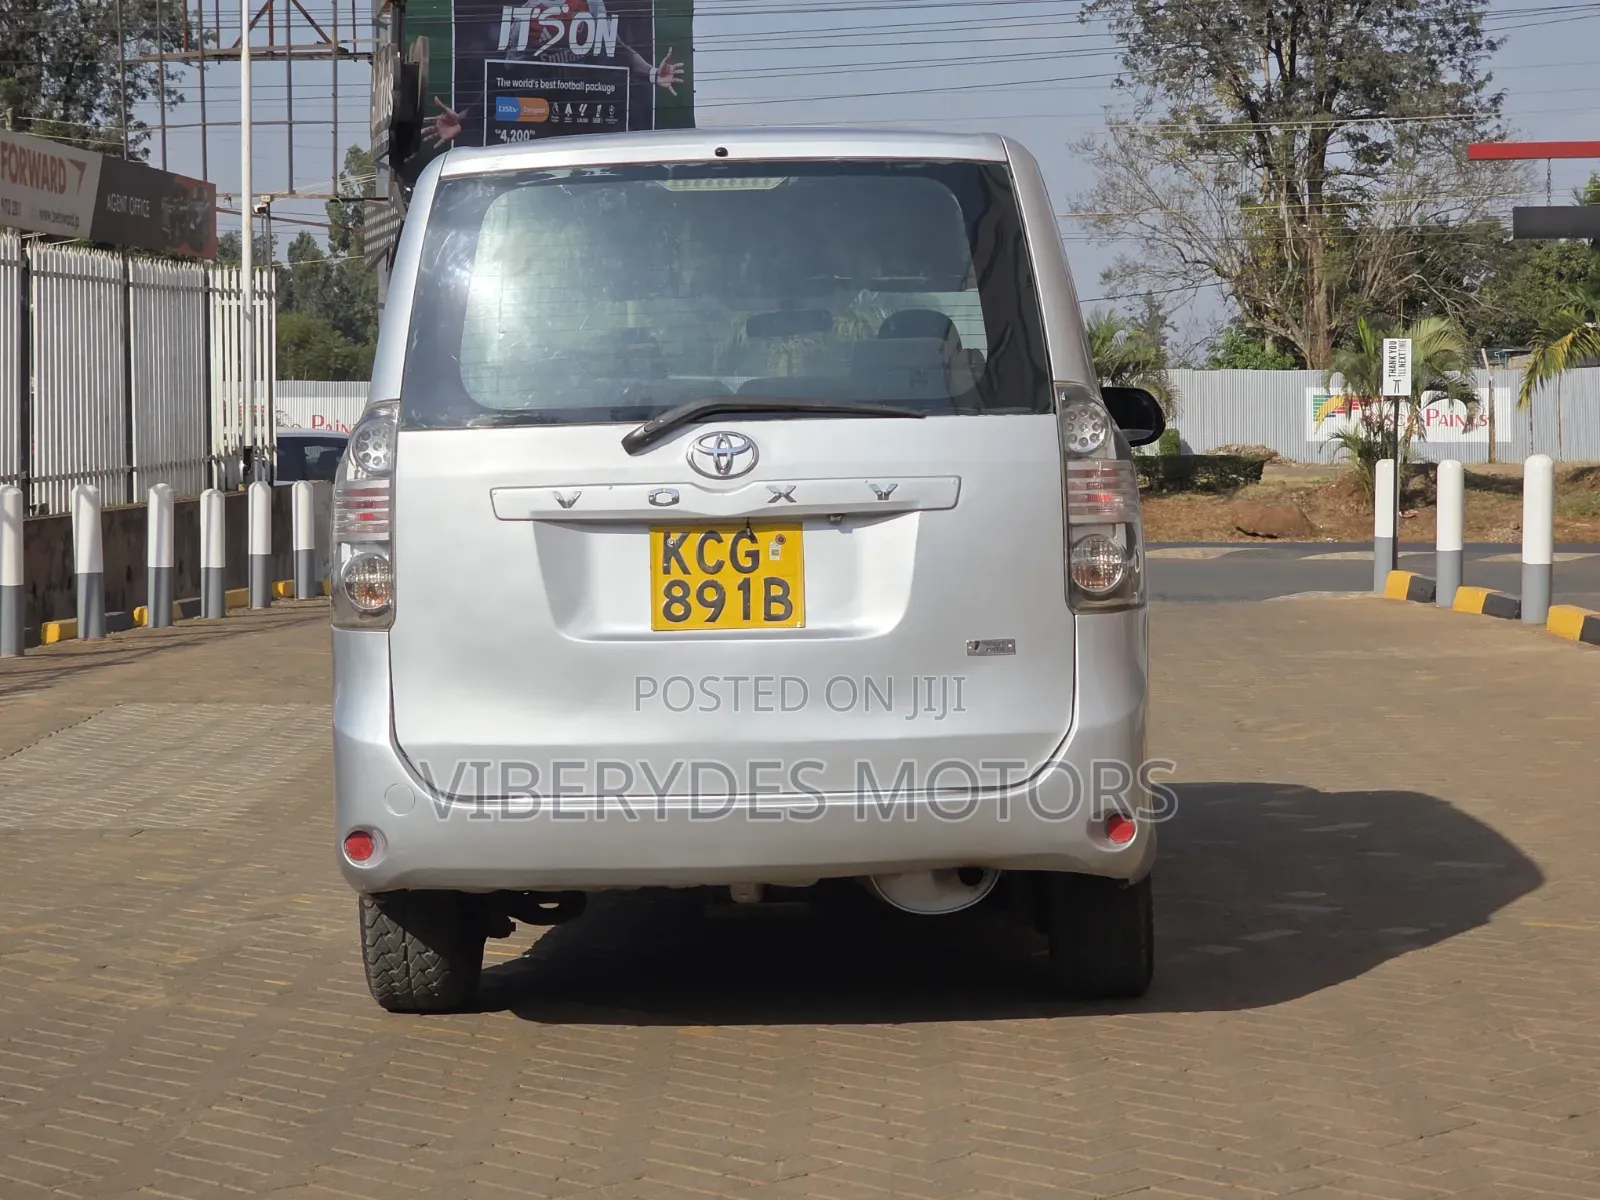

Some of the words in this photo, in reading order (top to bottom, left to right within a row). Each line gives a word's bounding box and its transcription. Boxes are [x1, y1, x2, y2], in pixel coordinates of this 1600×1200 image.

[498, 4, 569, 56] IT'S
[569, 11, 619, 57] ON
[497, 77, 511, 87] The
[512, 79, 539, 88] world's
[540, 79, 556, 89] best
[557, 80, 584, 91] football
[585, 82, 615, 94] package
[500, 129, 531, 144] 4,200
[1, 141, 67, 195] FORWARD
[106, 193, 128, 213] AGENT
[129, 197, 150, 218] OFFICE
[1388, 340, 1397, 354] YOU
[1388, 354, 1397, 378] THANK
[1398, 353, 1407, 368] NEXT
[552, 483, 898, 508] VOXY
[662, 530, 760, 575] KCG
[662, 577, 794, 623] 891B
